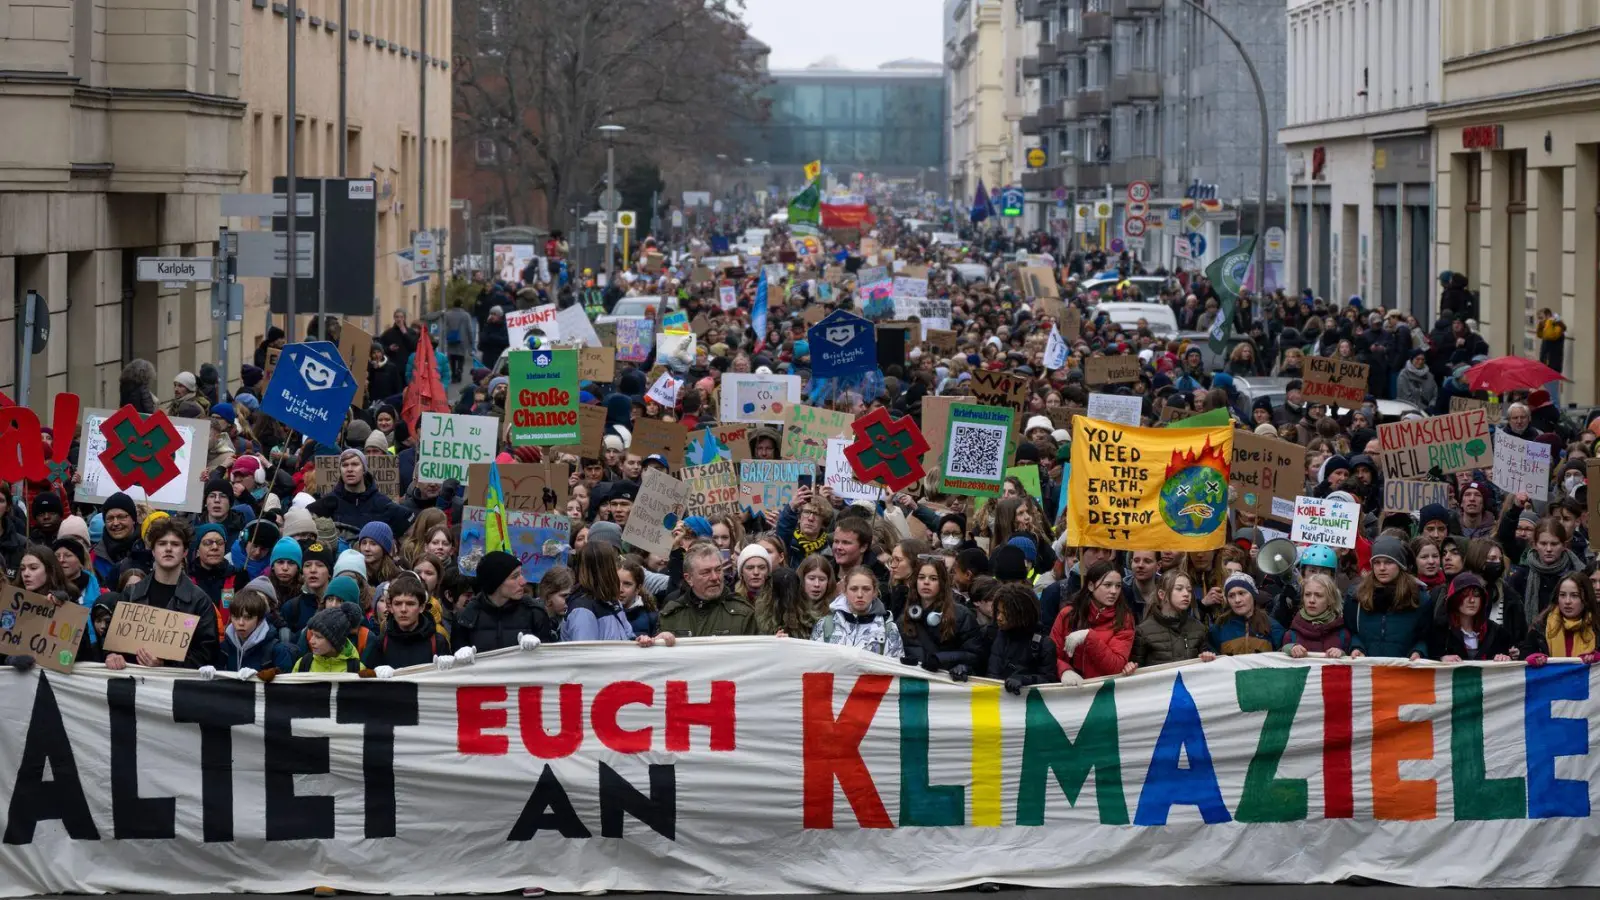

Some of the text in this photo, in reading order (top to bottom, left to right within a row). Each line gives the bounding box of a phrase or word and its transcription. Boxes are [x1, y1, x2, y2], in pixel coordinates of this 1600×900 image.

[350, 185, 364, 193] ABG
[1133, 186, 1146, 197] 30
[1188, 178, 1216, 199] dm
[157, 262, 196, 277] Karlplatz
[508, 308, 556, 329] ZUKUNFT
[1340, 363, 1365, 380] BOCK
[281, 388, 329, 422] Briefwahl
[518, 387, 570, 407] Große
[513, 408, 577, 427] Chance
[953, 407, 1009, 422] Briefwahl hier:
[430, 415, 455, 438] JA
[1084, 426, 1123, 444] YOU
[1379, 409, 1489, 451] KLIMASCHUTZ
[421, 439, 491, 462] LEBENS-
[1089, 443, 1141, 463] NEED
[1231, 447, 1292, 467] here is no
[1385, 441, 1466, 479] WEIL BAUM
[316, 456, 332, 469] THE
[683, 465, 707, 480] IT'S
[708, 460, 731, 477] OUR
[740, 460, 772, 483] GANZ
[827, 473, 842, 487] NO
[1110, 465, 1149, 481] THIS
[944, 478, 1000, 492] berlin2030.org
[1088, 478, 1143, 495] EARTH,
[689, 493, 706, 507] SO
[707, 487, 737, 505] STOP
[763, 483, 793, 509] EIS
[1088, 495, 1099, 506] SO
[1385, 480, 1404, 511] GO
[731, 500, 740, 515] IT
[1297, 505, 1326, 517] KOHLE
[507, 512, 550, 529] LASTIK
[553, 517, 569, 531] ins
[1088, 510, 1155, 526] DESTROY
[1309, 516, 1353, 531] ZUKUNFT
[1108, 529, 1131, 540] IT
[1301, 531, 1348, 546] KRAFTWERK
[11, 591, 57, 619] Spread
[120, 603, 180, 629] THERE IS
[2, 630, 23, 646] not
[48, 620, 84, 646] LOVE
[115, 622, 191, 649] NO PLANET B
[456, 680, 737, 760] EUCH
[802, 663, 1592, 830] KLIMAZIELE
[507, 762, 677, 842] AN
